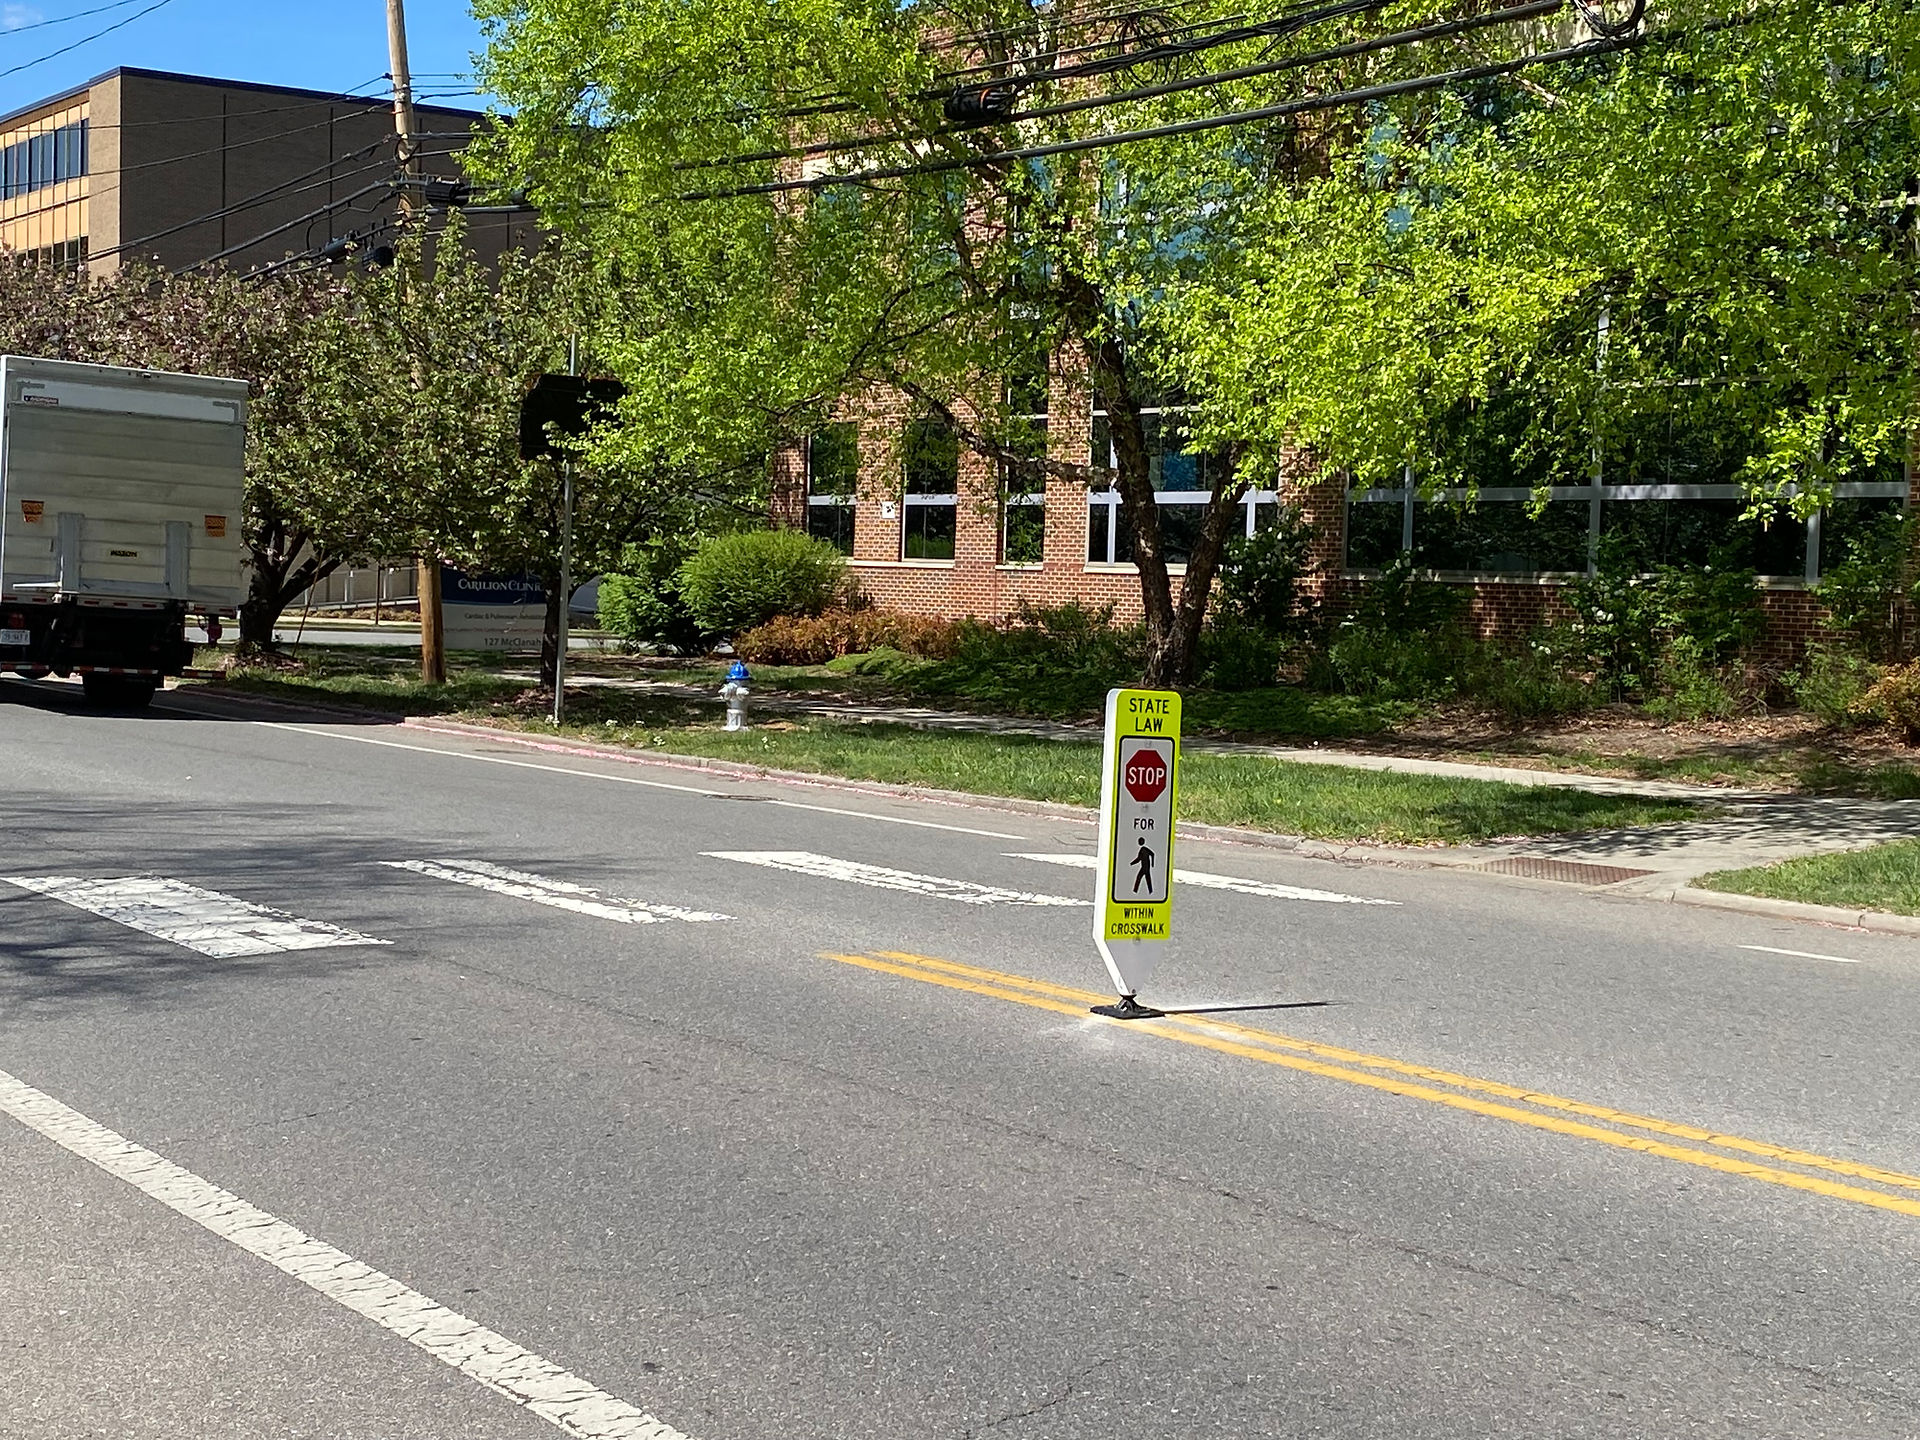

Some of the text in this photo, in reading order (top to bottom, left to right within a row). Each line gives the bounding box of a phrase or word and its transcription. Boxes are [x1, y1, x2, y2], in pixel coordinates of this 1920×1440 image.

[484, 638, 499, 646] 127
[1129, 698, 1170, 714] STATE
[1135, 717, 1163, 732] LAW
[1128, 767, 1165, 785] STOP
[1133, 818, 1155, 830] FOR
[1123, 907, 1154, 919] WITHIN
[1111, 923, 1164, 935] CROSSWALK
